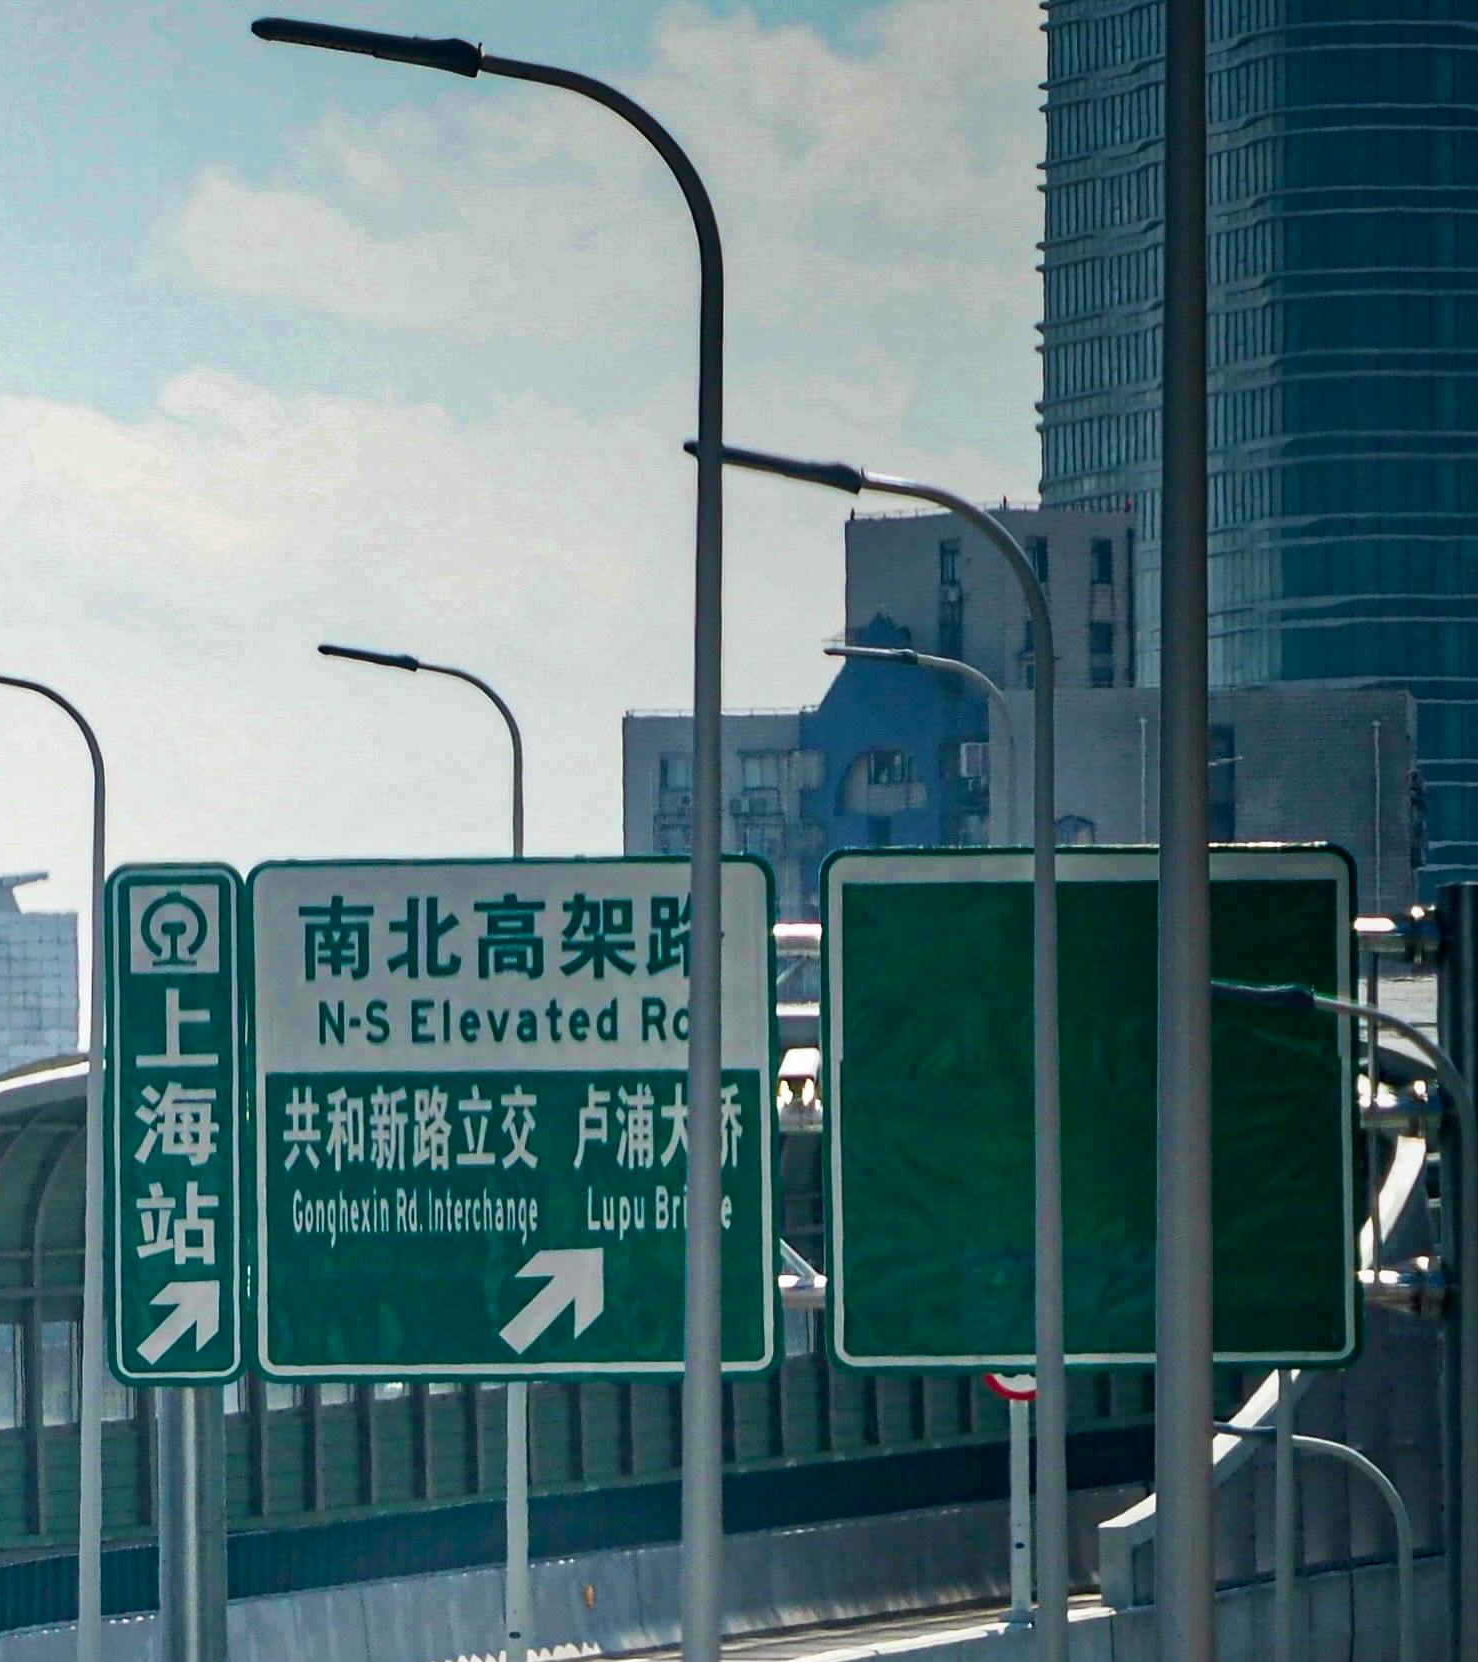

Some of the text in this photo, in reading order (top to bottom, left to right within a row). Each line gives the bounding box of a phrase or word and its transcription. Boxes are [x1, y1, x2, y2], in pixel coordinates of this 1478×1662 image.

[317, 999, 392, 1045] N-S
[410, 997, 619, 1044] Elevated
[133, 986, 220, 1266] 上海站
[282, 1083, 540, 1172] 共和新路立交
[292, 1186, 539, 1249] Gonghexin Rd. Interchange
[586, 1184, 733, 1241] Lupu Brie
